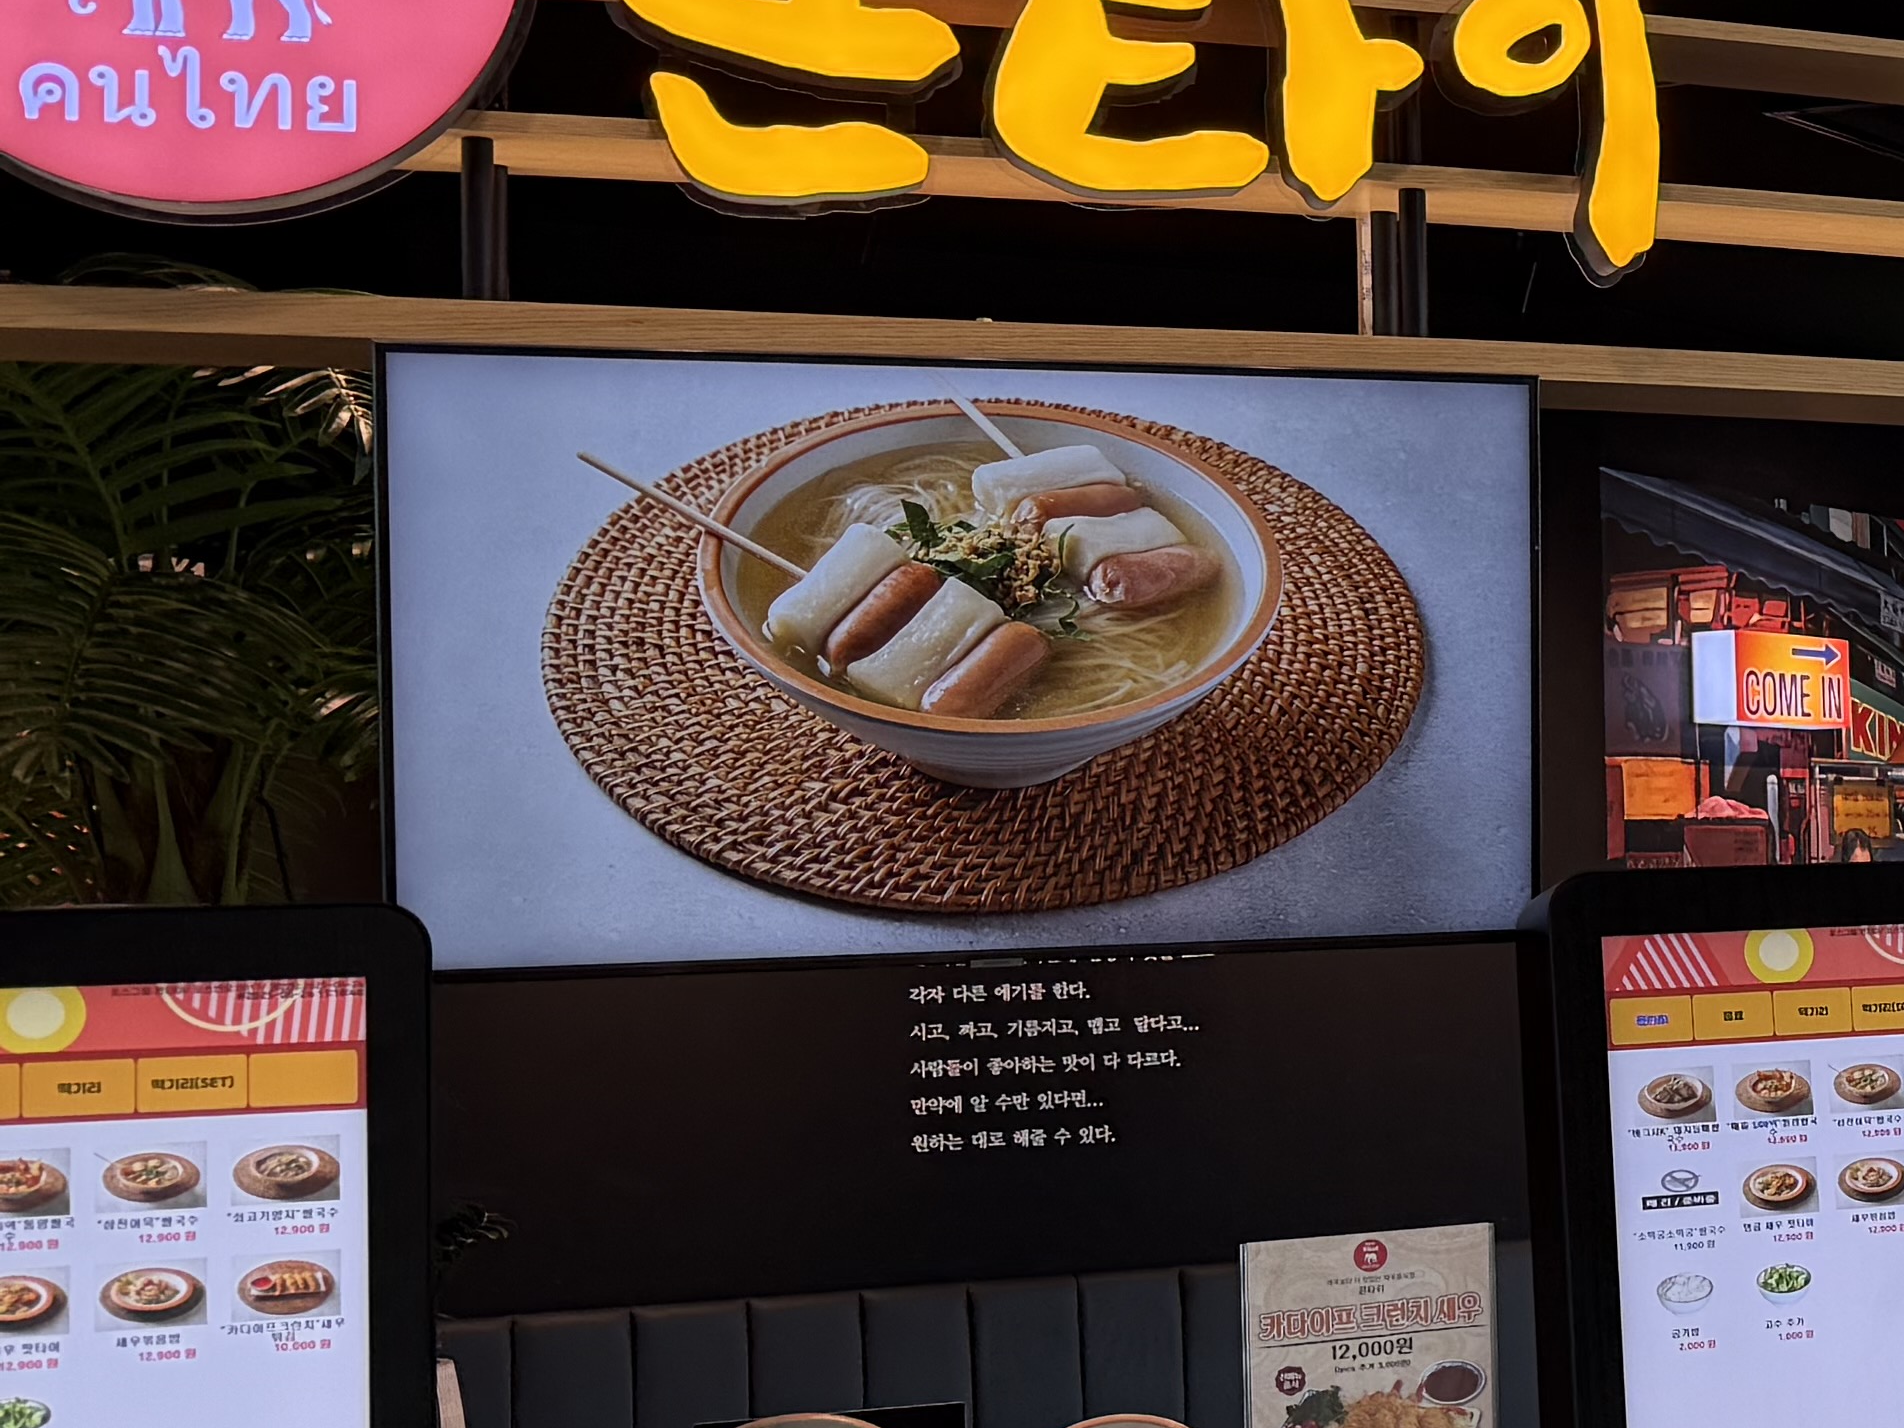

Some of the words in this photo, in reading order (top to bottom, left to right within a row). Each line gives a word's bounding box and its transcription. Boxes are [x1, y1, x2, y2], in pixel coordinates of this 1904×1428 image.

[18, 45, 358, 133] คนไทย
[1744, 668, 1811, 720] COME
[1821, 672, 1844, 721] IN
[909, 984, 945, 1004] 각자
[1062, 1053, 1095, 1073] 맛이
[1103, 1051, 1121, 1070] 다
[910, 1133, 964, 1154] 원하는
[1054, 1127, 1071, 1147] 수
[1258, 1304, 1358, 1342] 카다이프
[1359, 1295, 1432, 1332] 크런치
[1435, 1290, 1484, 1324] 새우
[1331, 1336, 1414, 1362] 12,000원
